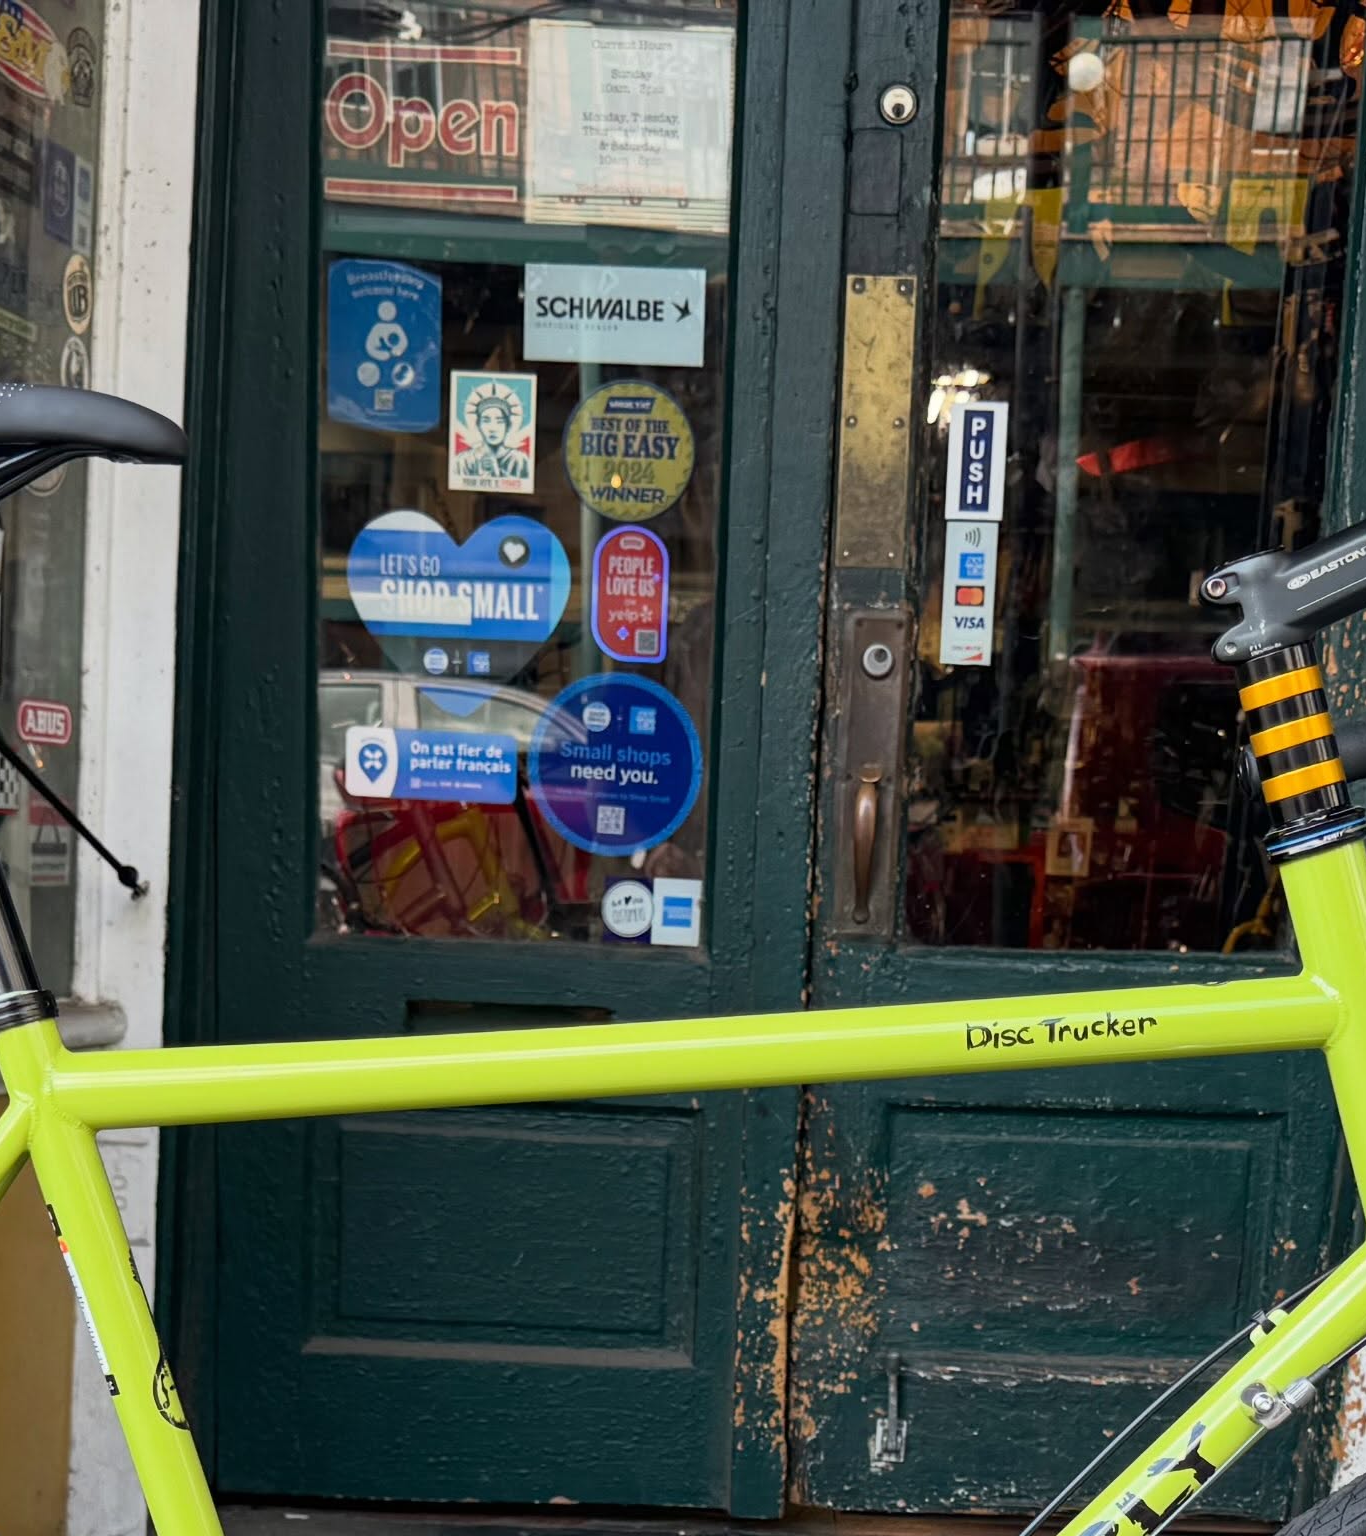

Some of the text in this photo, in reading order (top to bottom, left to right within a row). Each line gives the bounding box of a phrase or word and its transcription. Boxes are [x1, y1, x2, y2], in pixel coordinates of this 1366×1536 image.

[610, 68, 653, 82] Sunday
[325, 72, 520, 168] Open
[536, 296, 664, 322] SCHWALBE
[591, 416, 670, 434] BEST OF THE
[580, 432, 680, 460] BIG EASY
[603, 460, 655, 484] 2024
[966, 416, 987, 505] PUSH
[590, 485, 665, 504] WINNER
[380, 553, 441, 577] LET'S GO
[609, 555, 654, 576] PEOPLE
[606, 576, 655, 597] LOVE US
[380, 578, 539, 621] SHOP SMALL
[608, 608, 640, 623] yelp
[954, 615, 985, 630] VISA
[24, 708, 67, 737] ABUS
[410, 741, 503, 759] On est fier de
[560, 741, 672, 767] Small shops
[410, 757, 512, 775] parler français
[570, 763, 659, 786] need you.
[965, 1011, 1158, 1051] Disc Trucker
